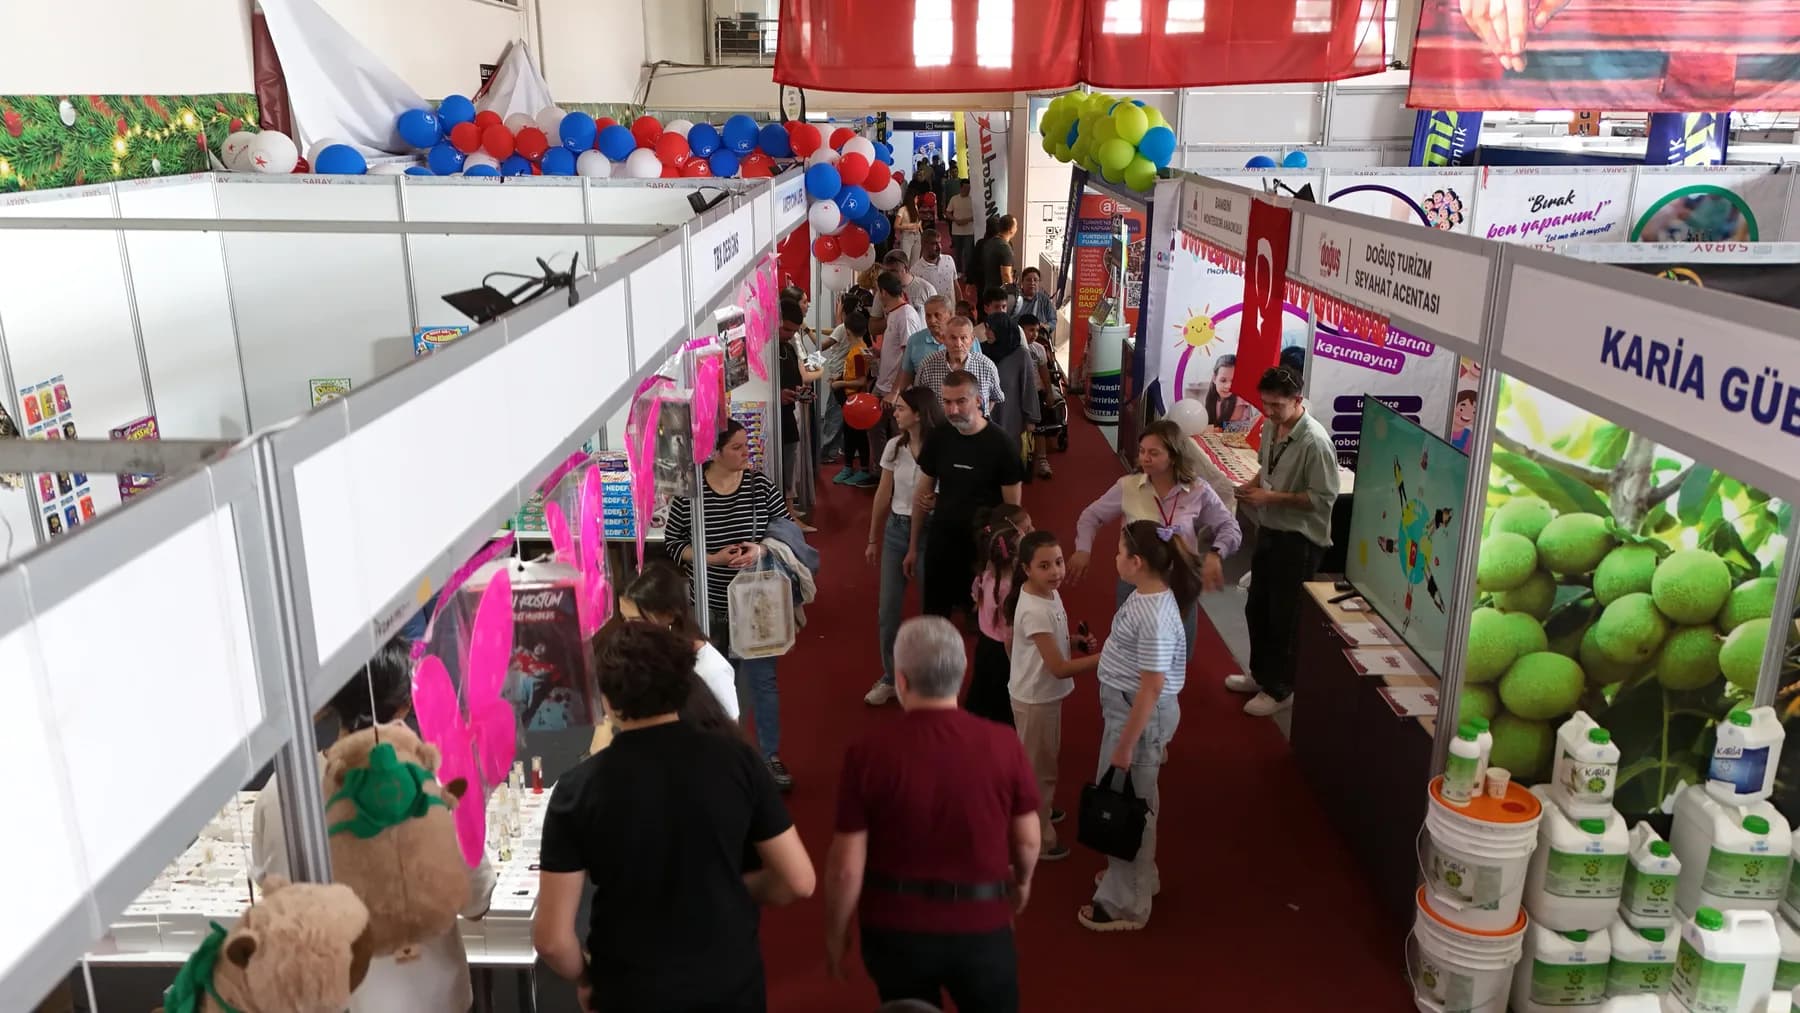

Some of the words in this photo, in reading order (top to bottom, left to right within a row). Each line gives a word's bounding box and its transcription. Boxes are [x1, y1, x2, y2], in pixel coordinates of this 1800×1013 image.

[1487, 224, 1517, 239] ben
[1366, 243, 1395, 276] DOĞUŞ
[1397, 251, 1432, 280] TURİZM
[1354, 269, 1392, 297] SEYAHAT
[1392, 283, 1441, 315] ACENTASI
[1316, 339, 1398, 369] kaçırmayın!
[1600, 325, 1705, 400] KARİA
